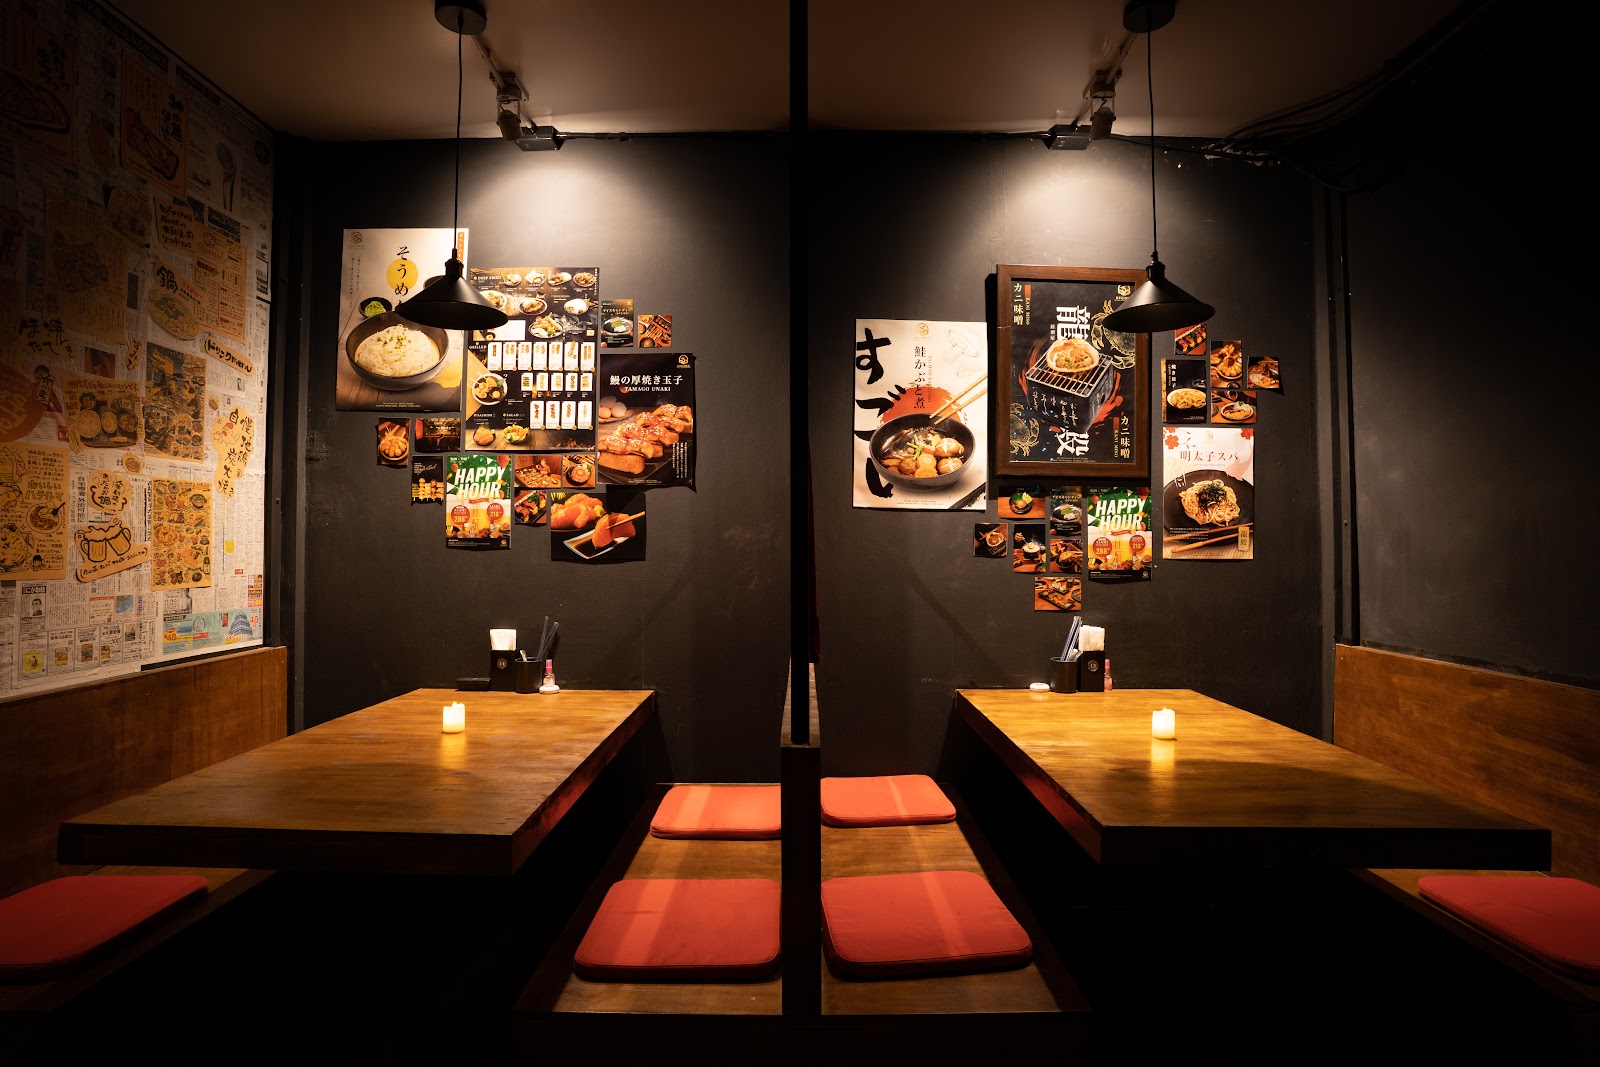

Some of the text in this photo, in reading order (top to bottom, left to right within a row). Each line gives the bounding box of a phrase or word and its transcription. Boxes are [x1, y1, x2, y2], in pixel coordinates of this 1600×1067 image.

[397, 245, 410, 305] そうめ
[1013, 282, 1024, 326] カニ味噌
[609, 374, 683, 386] 鰻の厚焼き玉子
[1120, 415, 1131, 459] カニ味噌
[1180, 450, 1238, 462] 明太子スパ
[454, 466, 506, 486] HAPPY
[457, 481, 502, 500] HOUR
[1095, 498, 1146, 517] HAPPY
[1099, 513, 1143, 532] HOUR
